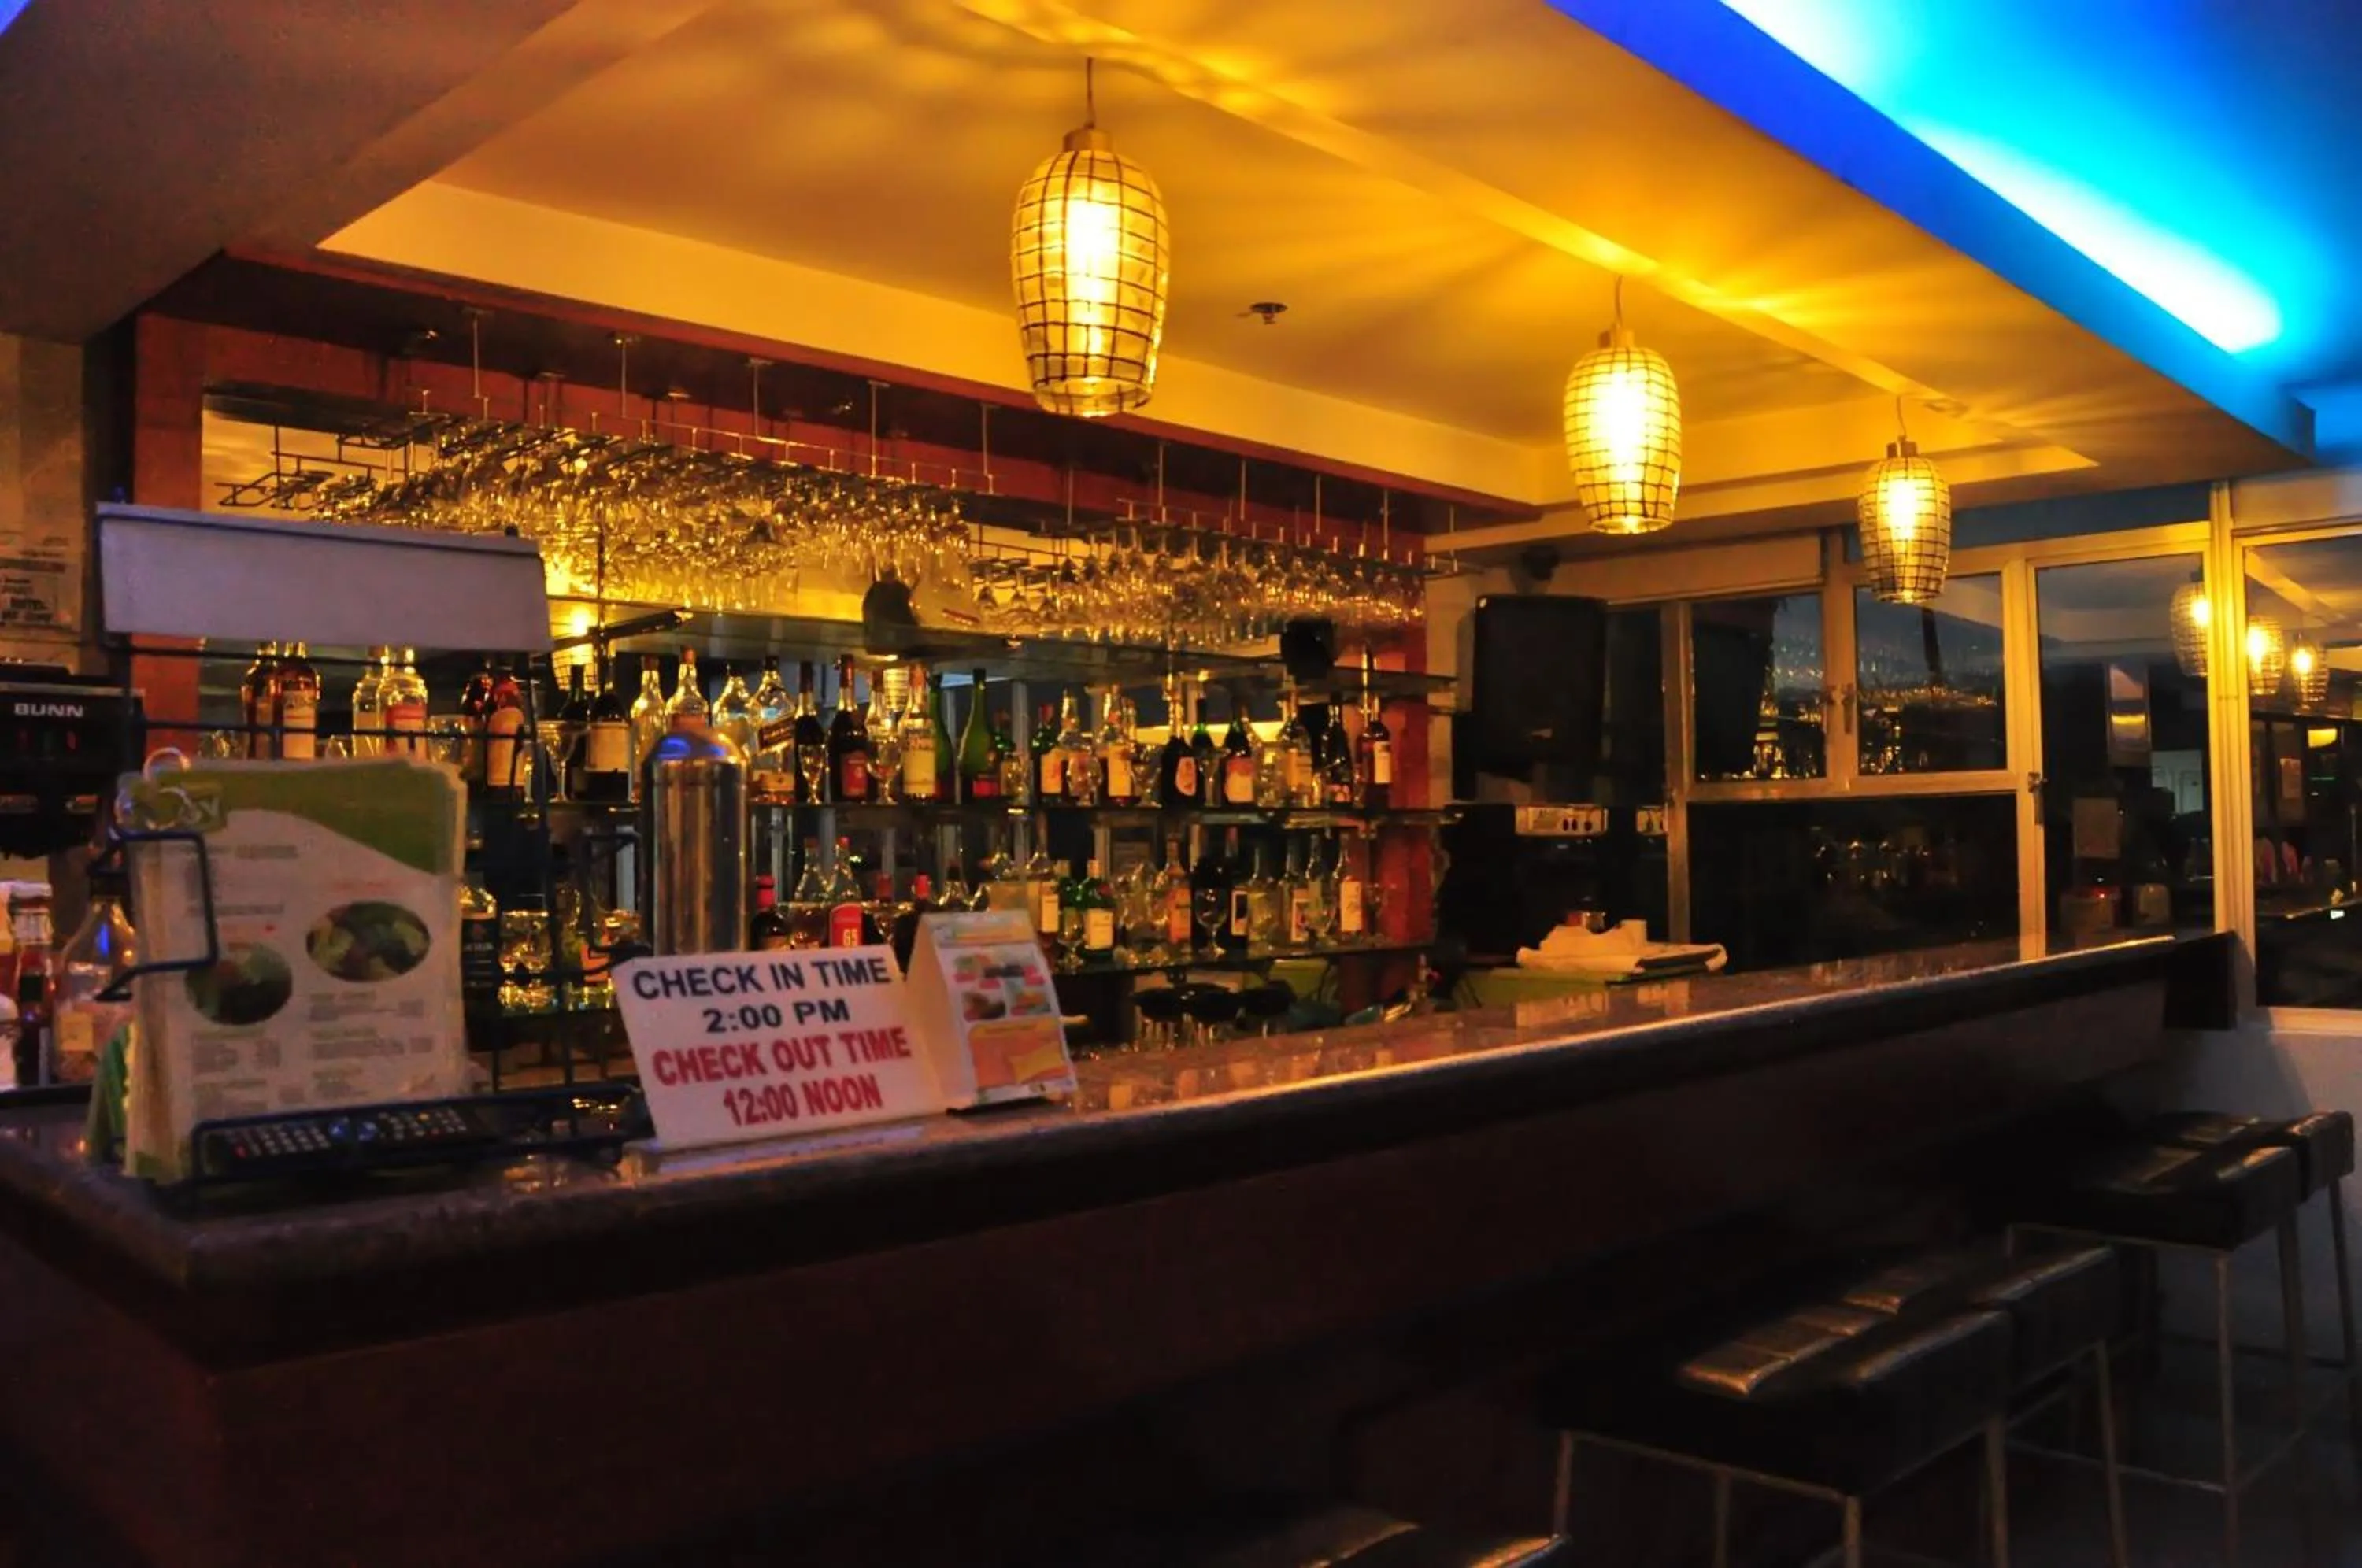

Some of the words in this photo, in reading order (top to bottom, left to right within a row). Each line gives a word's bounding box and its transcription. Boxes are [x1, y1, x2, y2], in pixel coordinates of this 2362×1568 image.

[14, 703, 83, 718] BUNN
[632, 965, 764, 1000] CHECK
[768, 961, 806, 990] IN
[810, 958, 891, 987] TIME
[702, 1005, 783, 1033] 2:00
[793, 999, 850, 1025] PM
[652, 1042, 768, 1086] CHECK
[772, 1034, 832, 1073] OUT
[838, 1027, 911, 1063] TIME
[723, 1083, 799, 1126] 12:00
[802, 1074, 883, 1116] NOON
